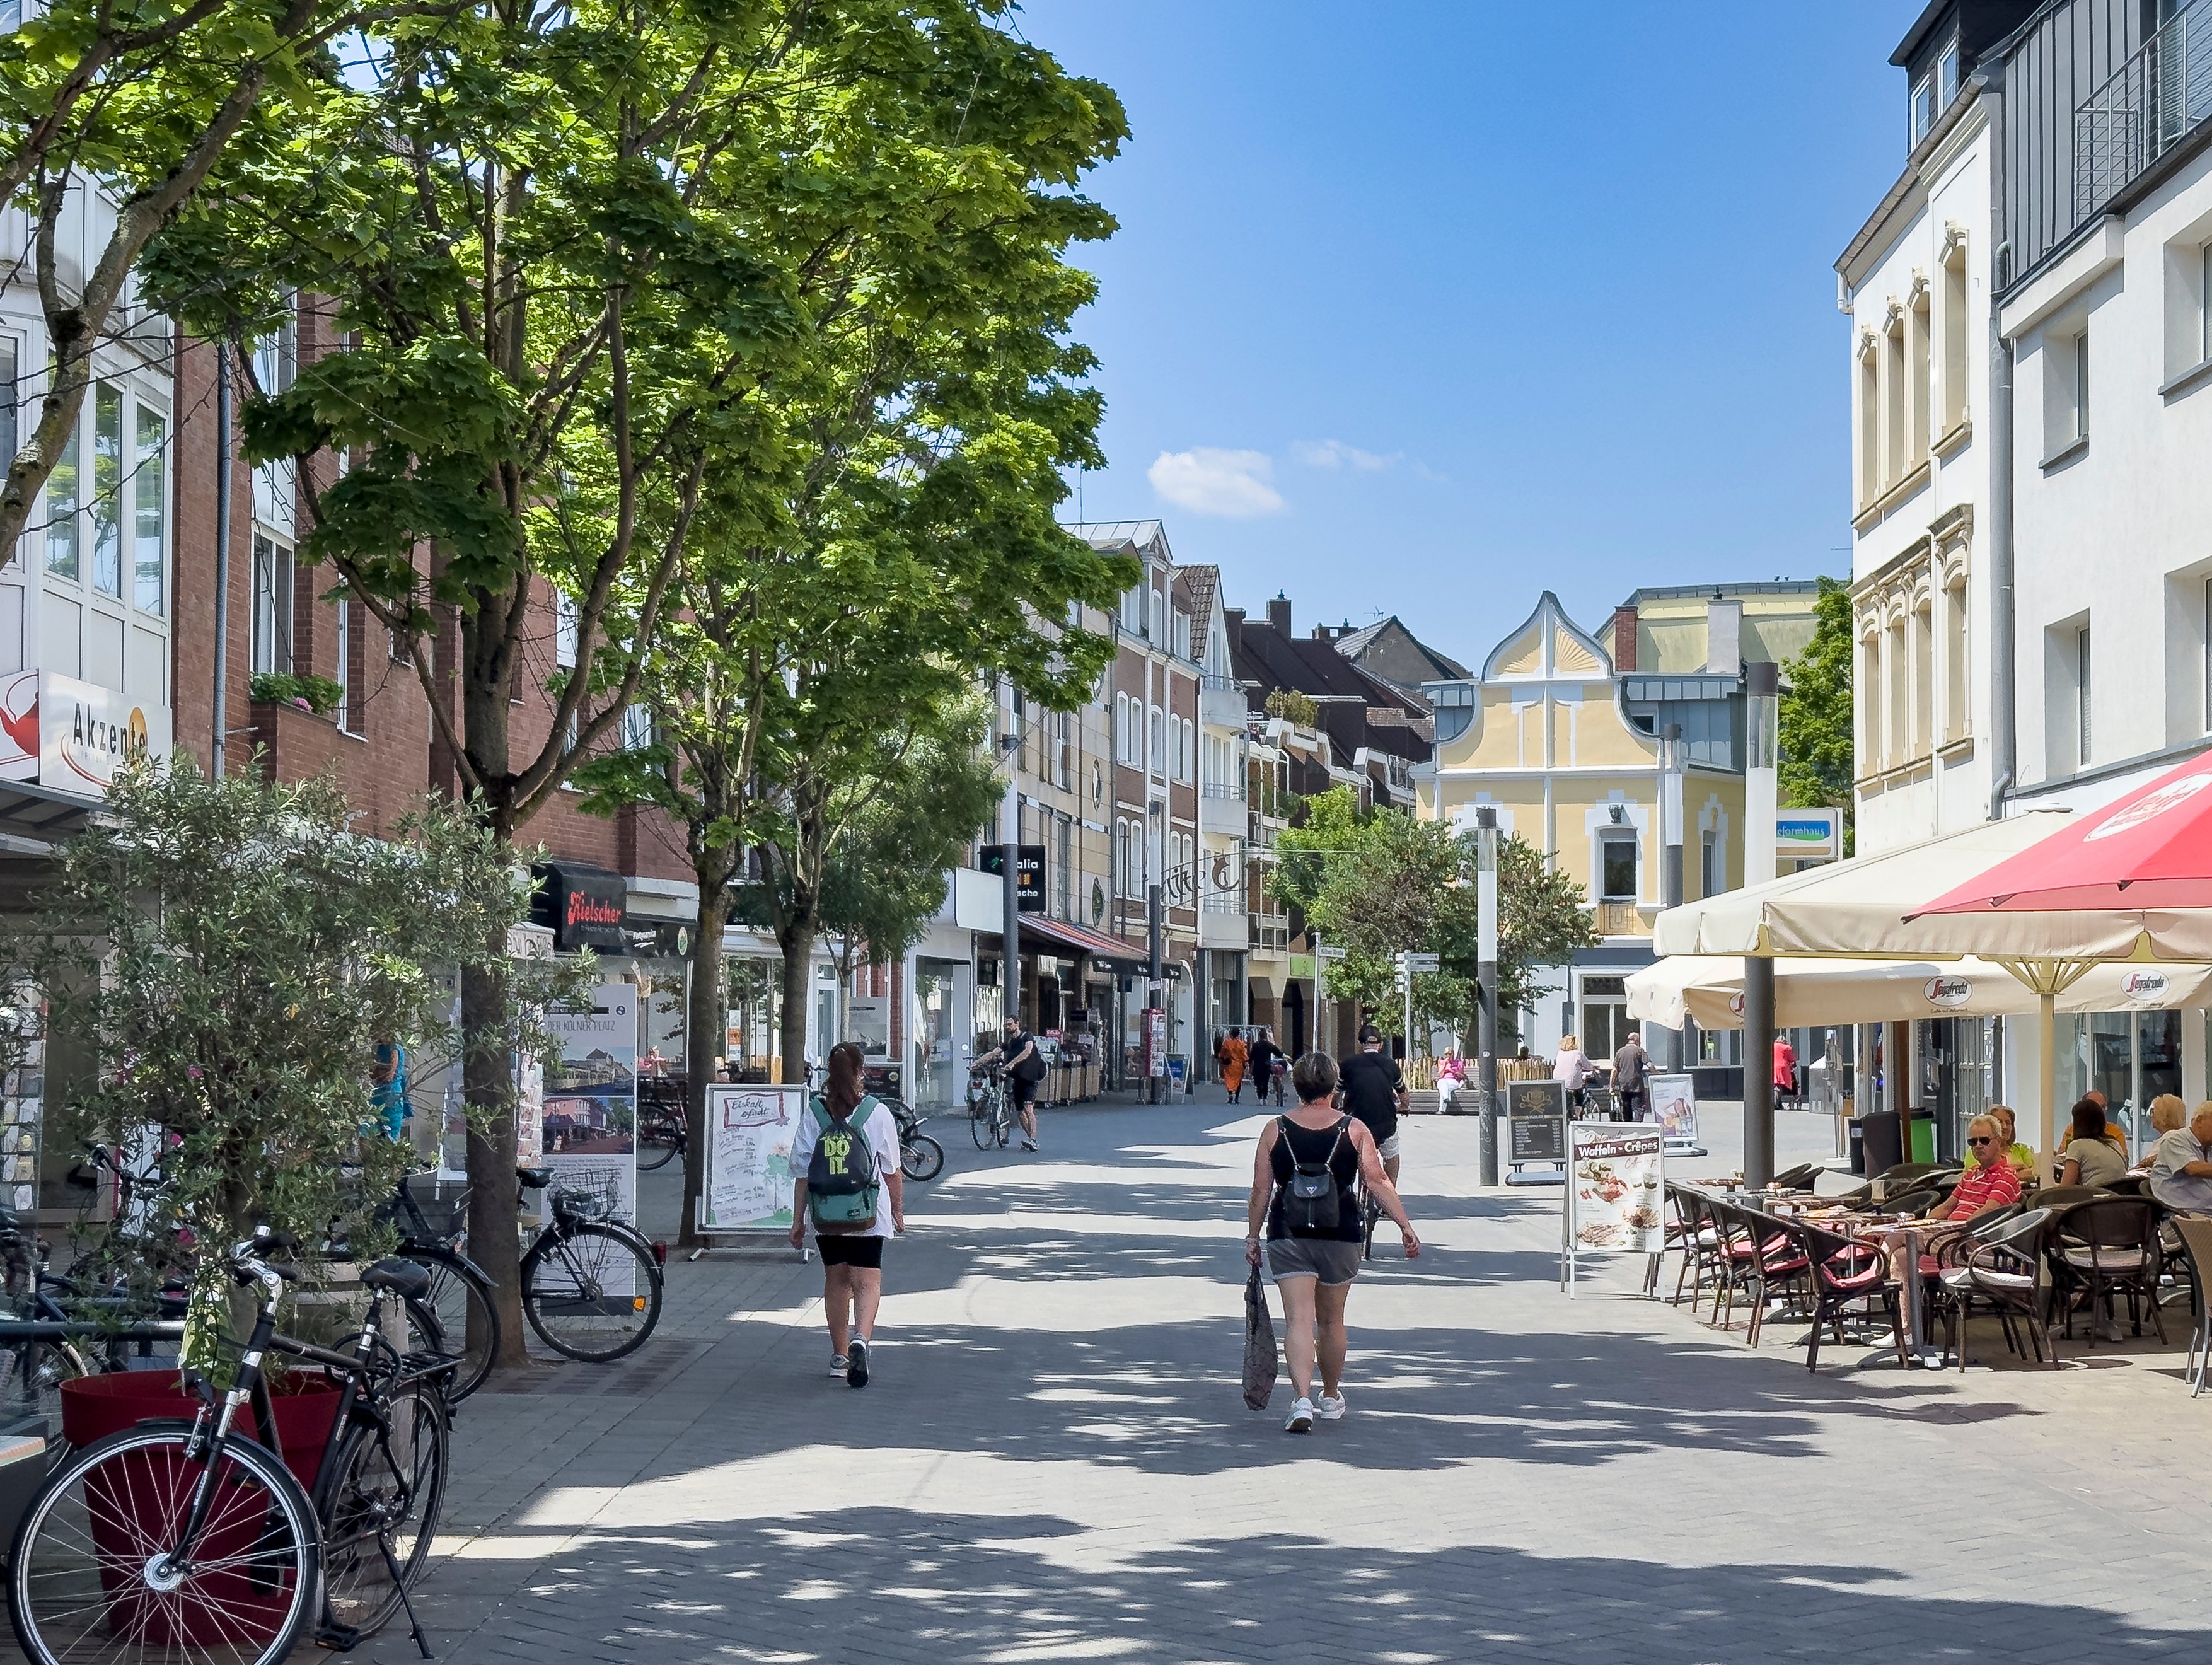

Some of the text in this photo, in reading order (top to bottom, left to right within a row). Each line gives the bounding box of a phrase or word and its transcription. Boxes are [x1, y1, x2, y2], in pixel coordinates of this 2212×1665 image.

[73, 702, 146, 762] Akzente
[1777, 825, 1826, 837] eformhaus
[1929, 979, 1968, 1000] Segafredo
[2126, 973, 2165, 993] Segafredo
[594, 1019, 616, 1031] PLATZ
[824, 1139, 850, 1157] DO
[1578, 1143, 1617, 1158] Waffeln
